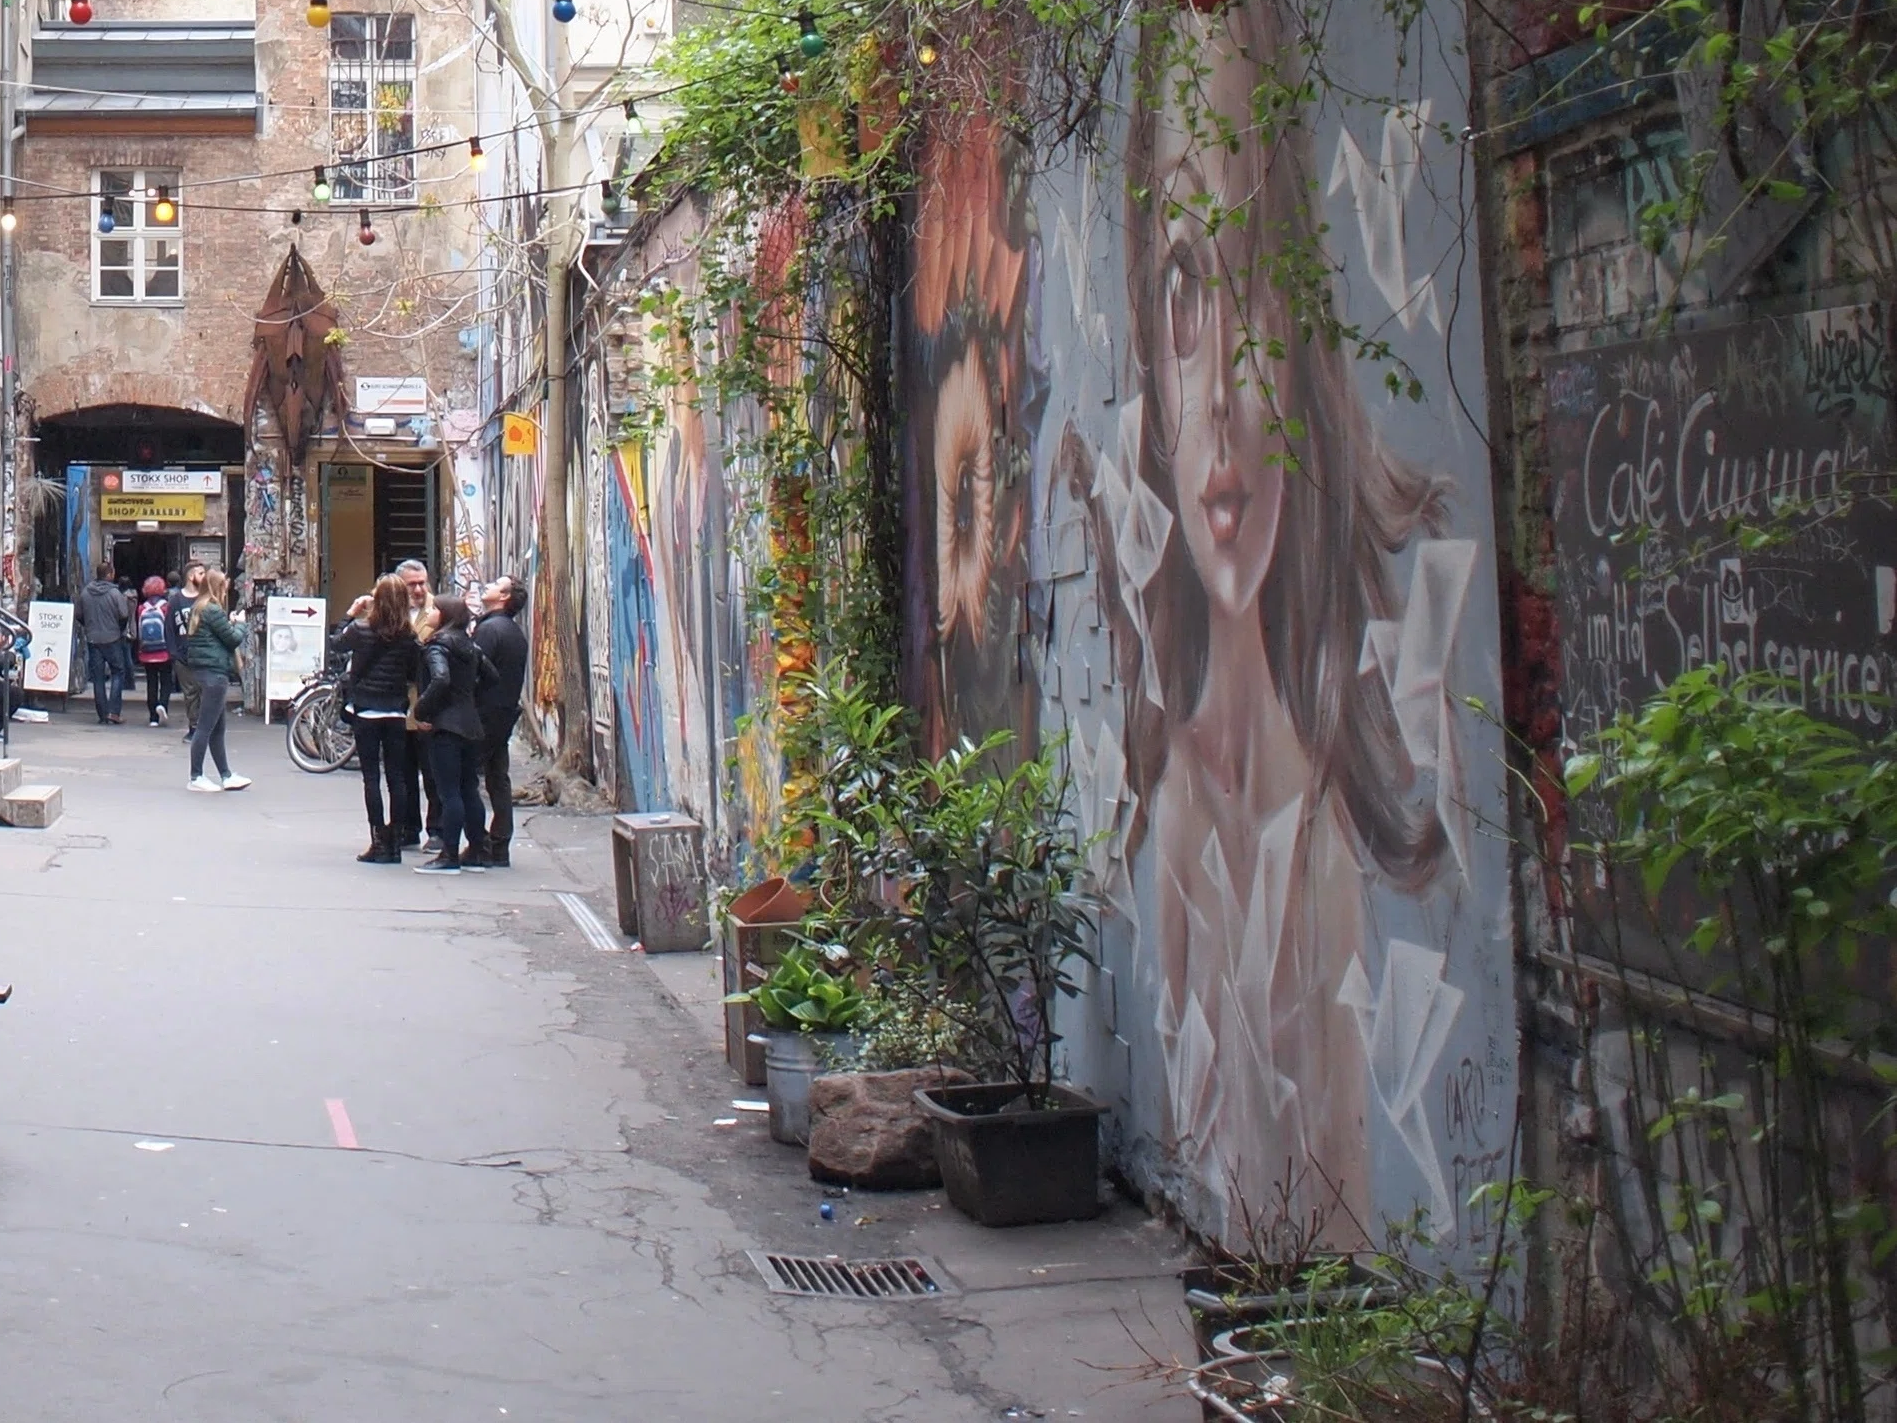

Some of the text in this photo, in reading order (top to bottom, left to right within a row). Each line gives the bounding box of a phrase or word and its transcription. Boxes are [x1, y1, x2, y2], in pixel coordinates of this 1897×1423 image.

[1675, 390, 1845, 528] Cinema
[130, 474, 189, 484] STOKX SHOP
[40, 621, 61, 629] SHOP
